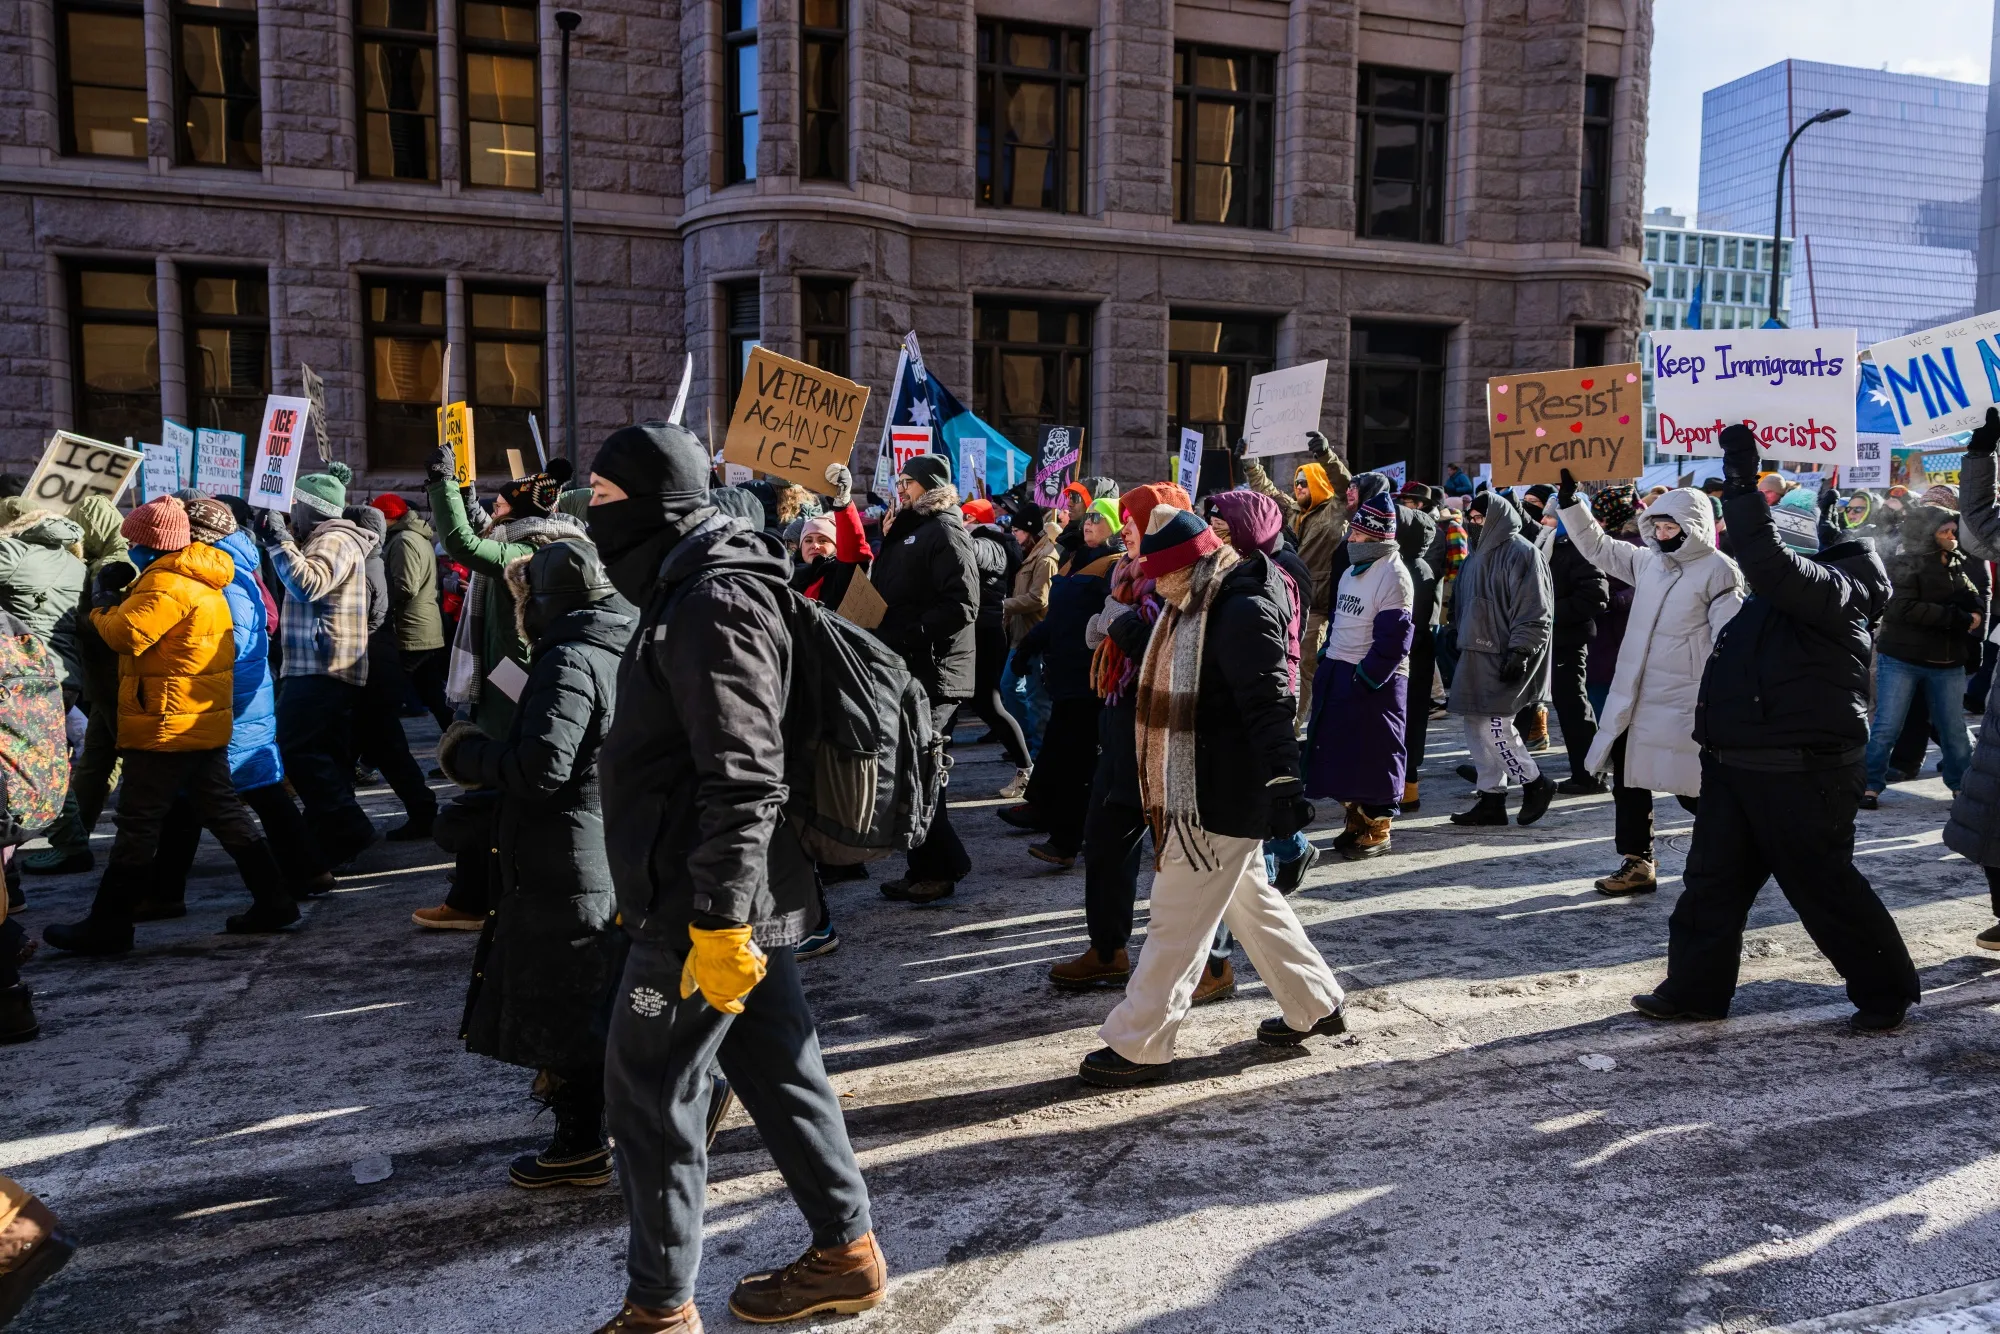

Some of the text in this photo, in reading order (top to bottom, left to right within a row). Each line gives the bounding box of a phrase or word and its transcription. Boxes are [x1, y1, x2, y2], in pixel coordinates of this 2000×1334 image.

[1945, 327, 1967, 339] are
[1973, 319, 1999, 332] the
[1656, 344, 1845, 386] Keep Immigrants
[758, 361, 860, 423] VETERANS
[1883, 346, 1971, 427] MN
[1515, 378, 1624, 425] Resist
[273, 409, 295, 433] ICE
[743, 399, 847, 453] AGAINST
[1955, 415, 1980, 428] are
[206, 432, 231, 445] STOP
[1659, 412, 1838, 453] Deport Racists
[269, 435, 291, 457] OUT
[756, 436, 811, 471] ICE
[1493, 429, 1625, 482] Tyranny
[1856, 441, 1880, 452] USTICE
[1864, 450, 1881, 460] ALEX
[55, 440, 131, 479] ICE
[267, 457, 282, 473] FOR
[1048, 461, 1057, 473] OF
[260, 473, 284, 494] GOOD
[1927, 471, 1955, 484] ICE
[1342, 600, 1365, 617] NOW
